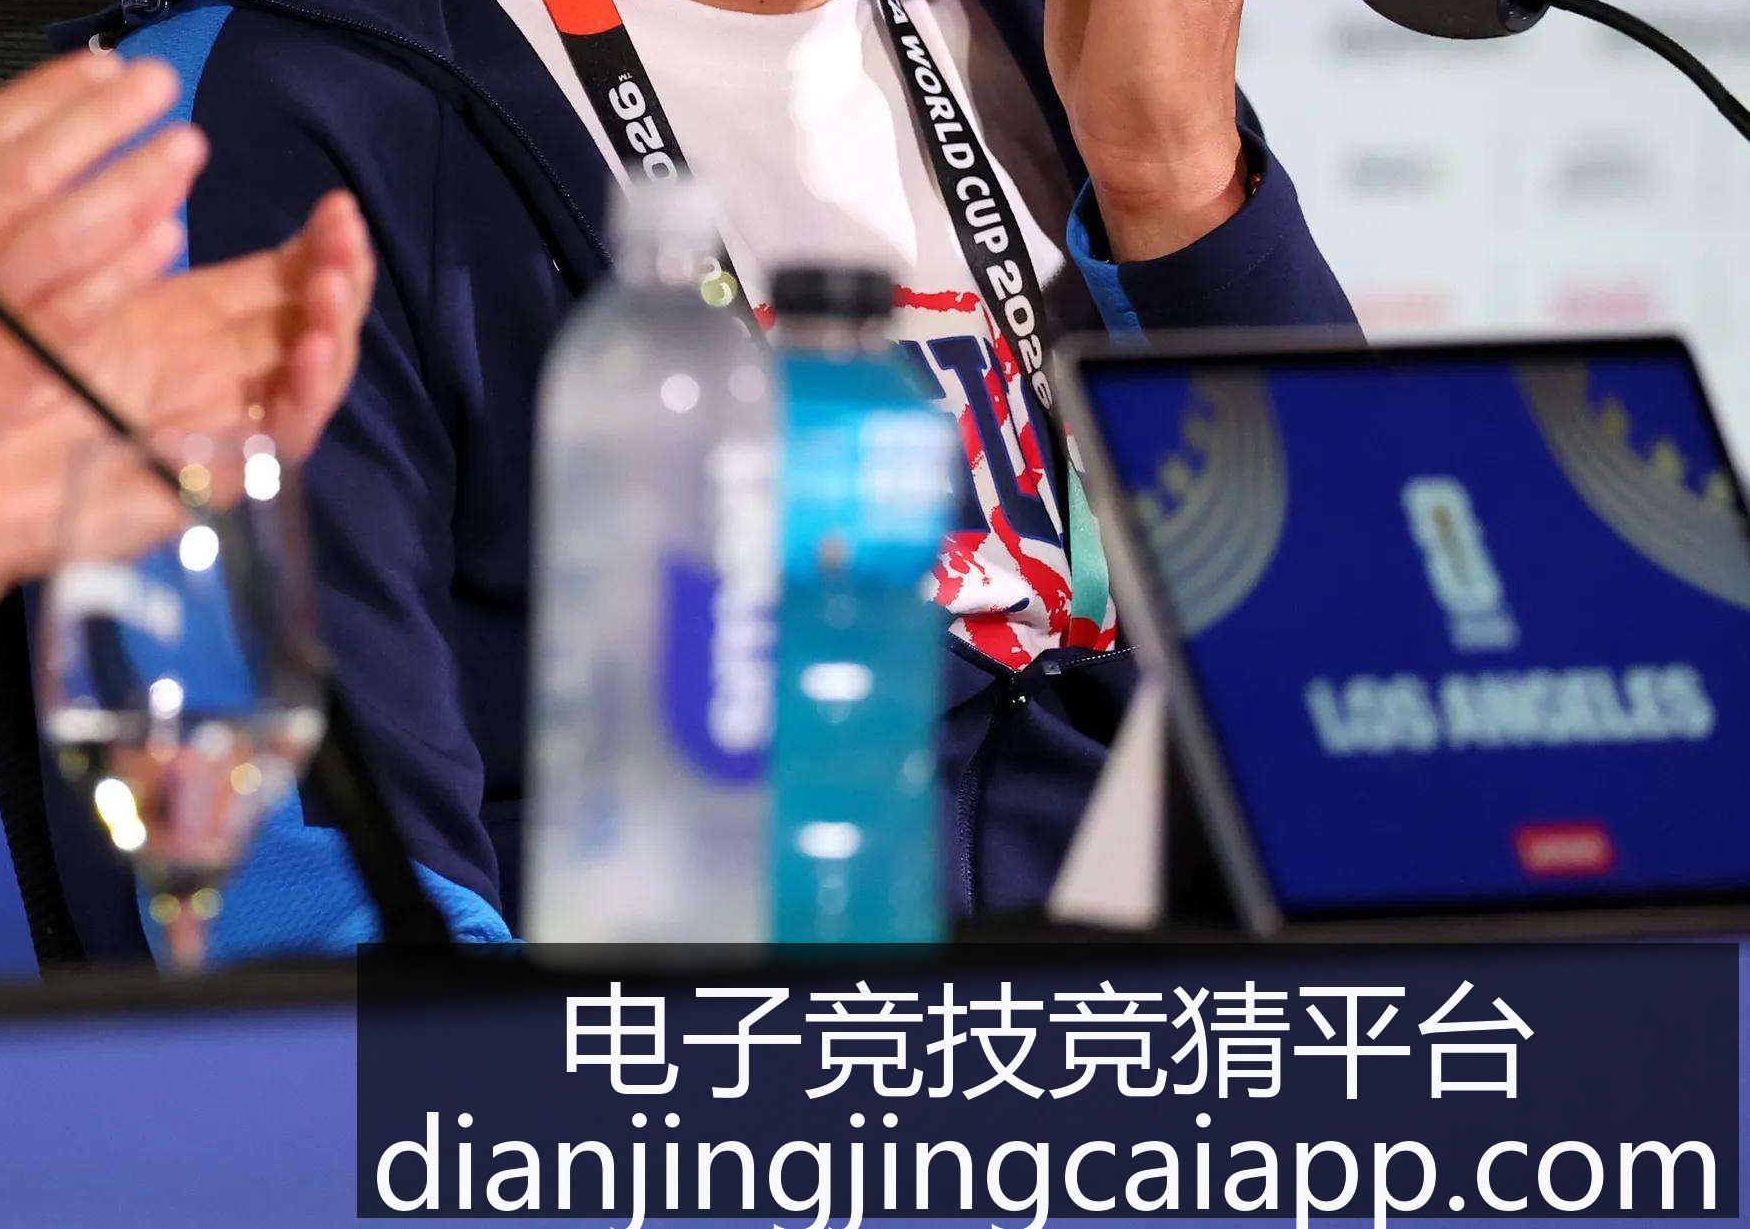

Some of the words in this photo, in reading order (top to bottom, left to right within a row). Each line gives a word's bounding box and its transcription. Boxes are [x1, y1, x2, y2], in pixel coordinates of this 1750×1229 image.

[901, 34, 976, 170] WORLD
[955, 175, 1010, 255] CUP
[986, 259, 1053, 410] 2026
